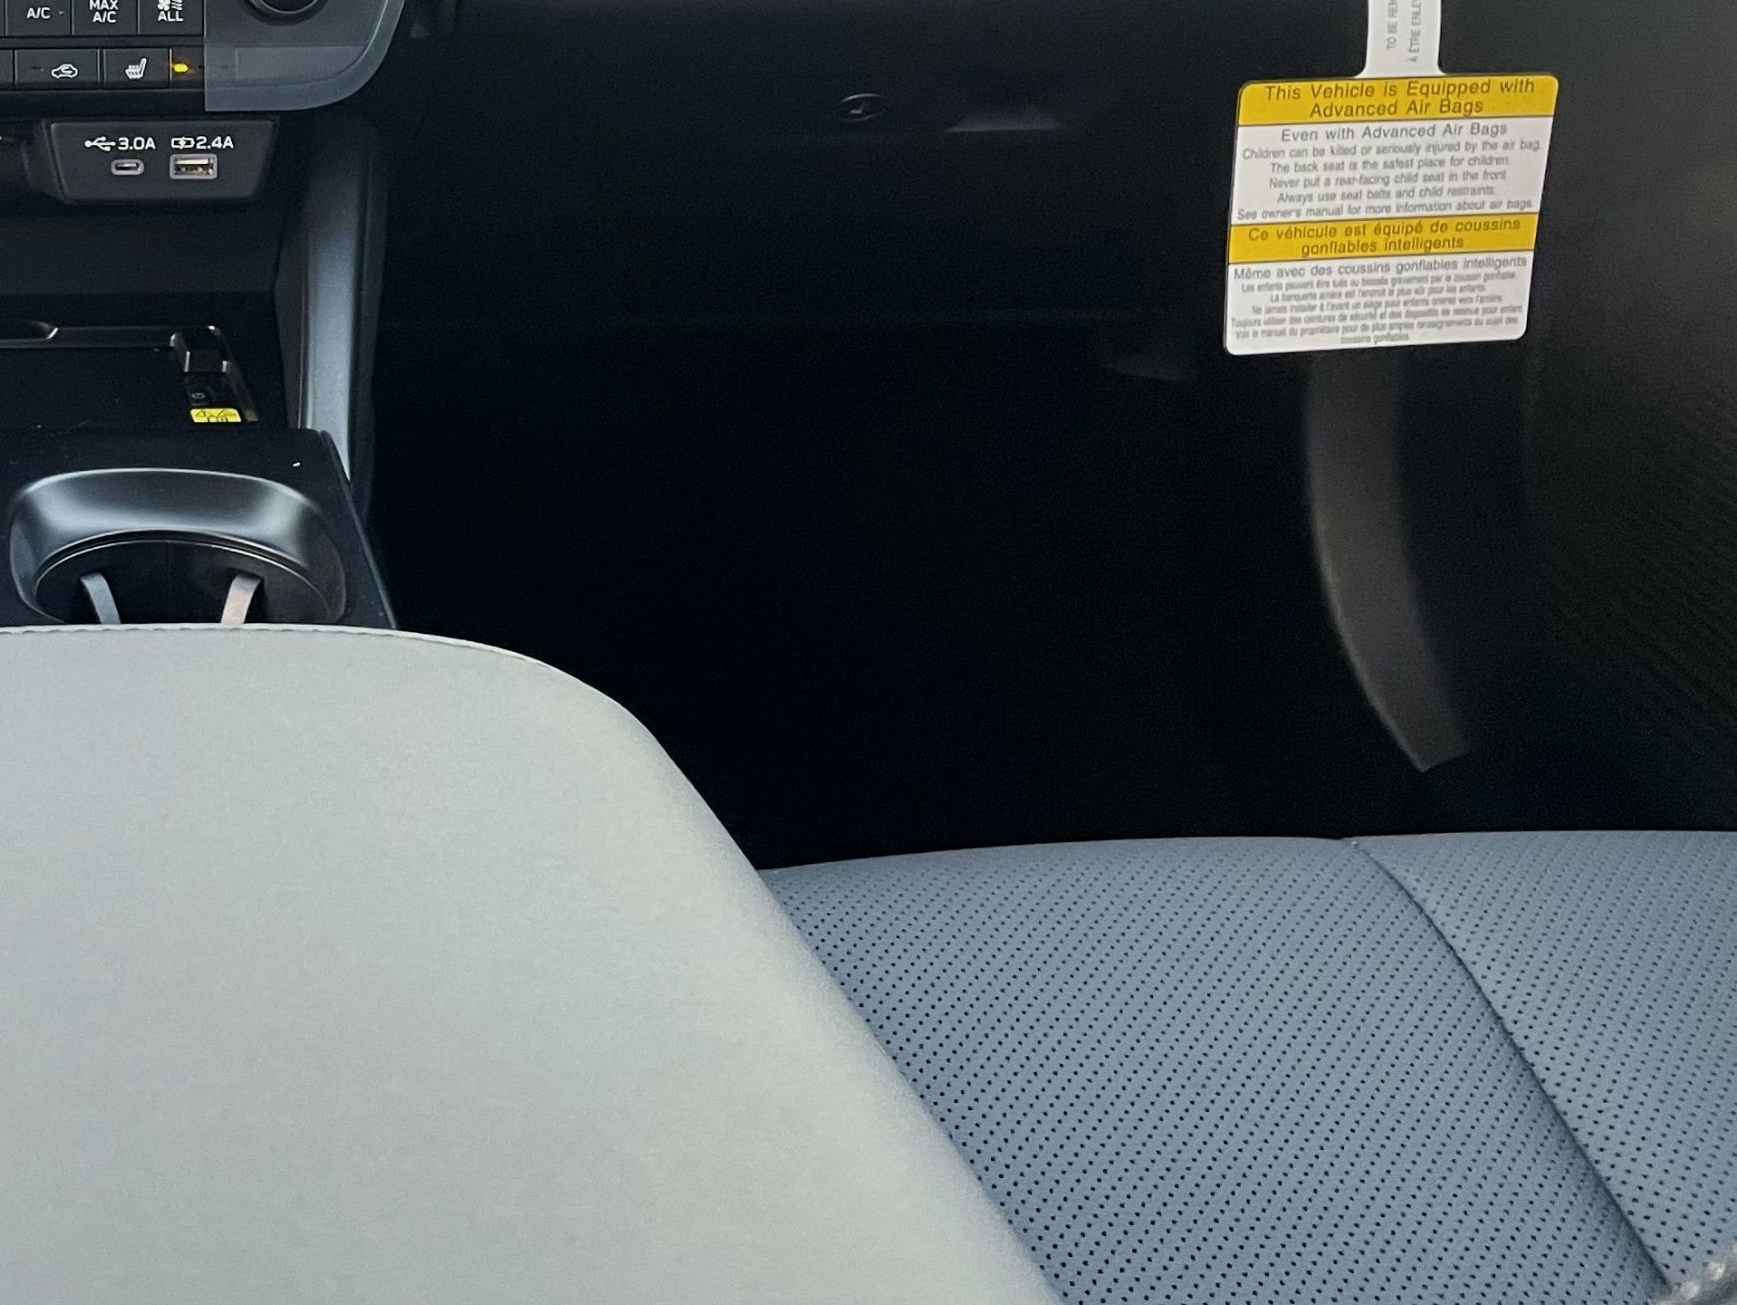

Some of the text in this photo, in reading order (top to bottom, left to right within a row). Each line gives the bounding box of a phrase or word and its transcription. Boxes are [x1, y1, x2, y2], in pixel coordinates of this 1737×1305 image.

[89, 0, 119, 10] MAX
[26, 7, 51, 19] A/C
[92, 11, 117, 23] A/C
[158, 11, 183, 22] ALL
[1266, 77, 1534, 101] This Vehicle is Equipped with
[1310, 96, 1483, 119] Advanced Air Bags
[1281, 121, 1507, 143] Even with Advanced Air Bags
[118, 136, 156, 151] 3.0A
[196, 136, 234, 150] 2.4A
[1248, 217, 1520, 243] Ce véhicule est équipé de coussins
[1301, 235, 1464, 257] gonflables intelligents
